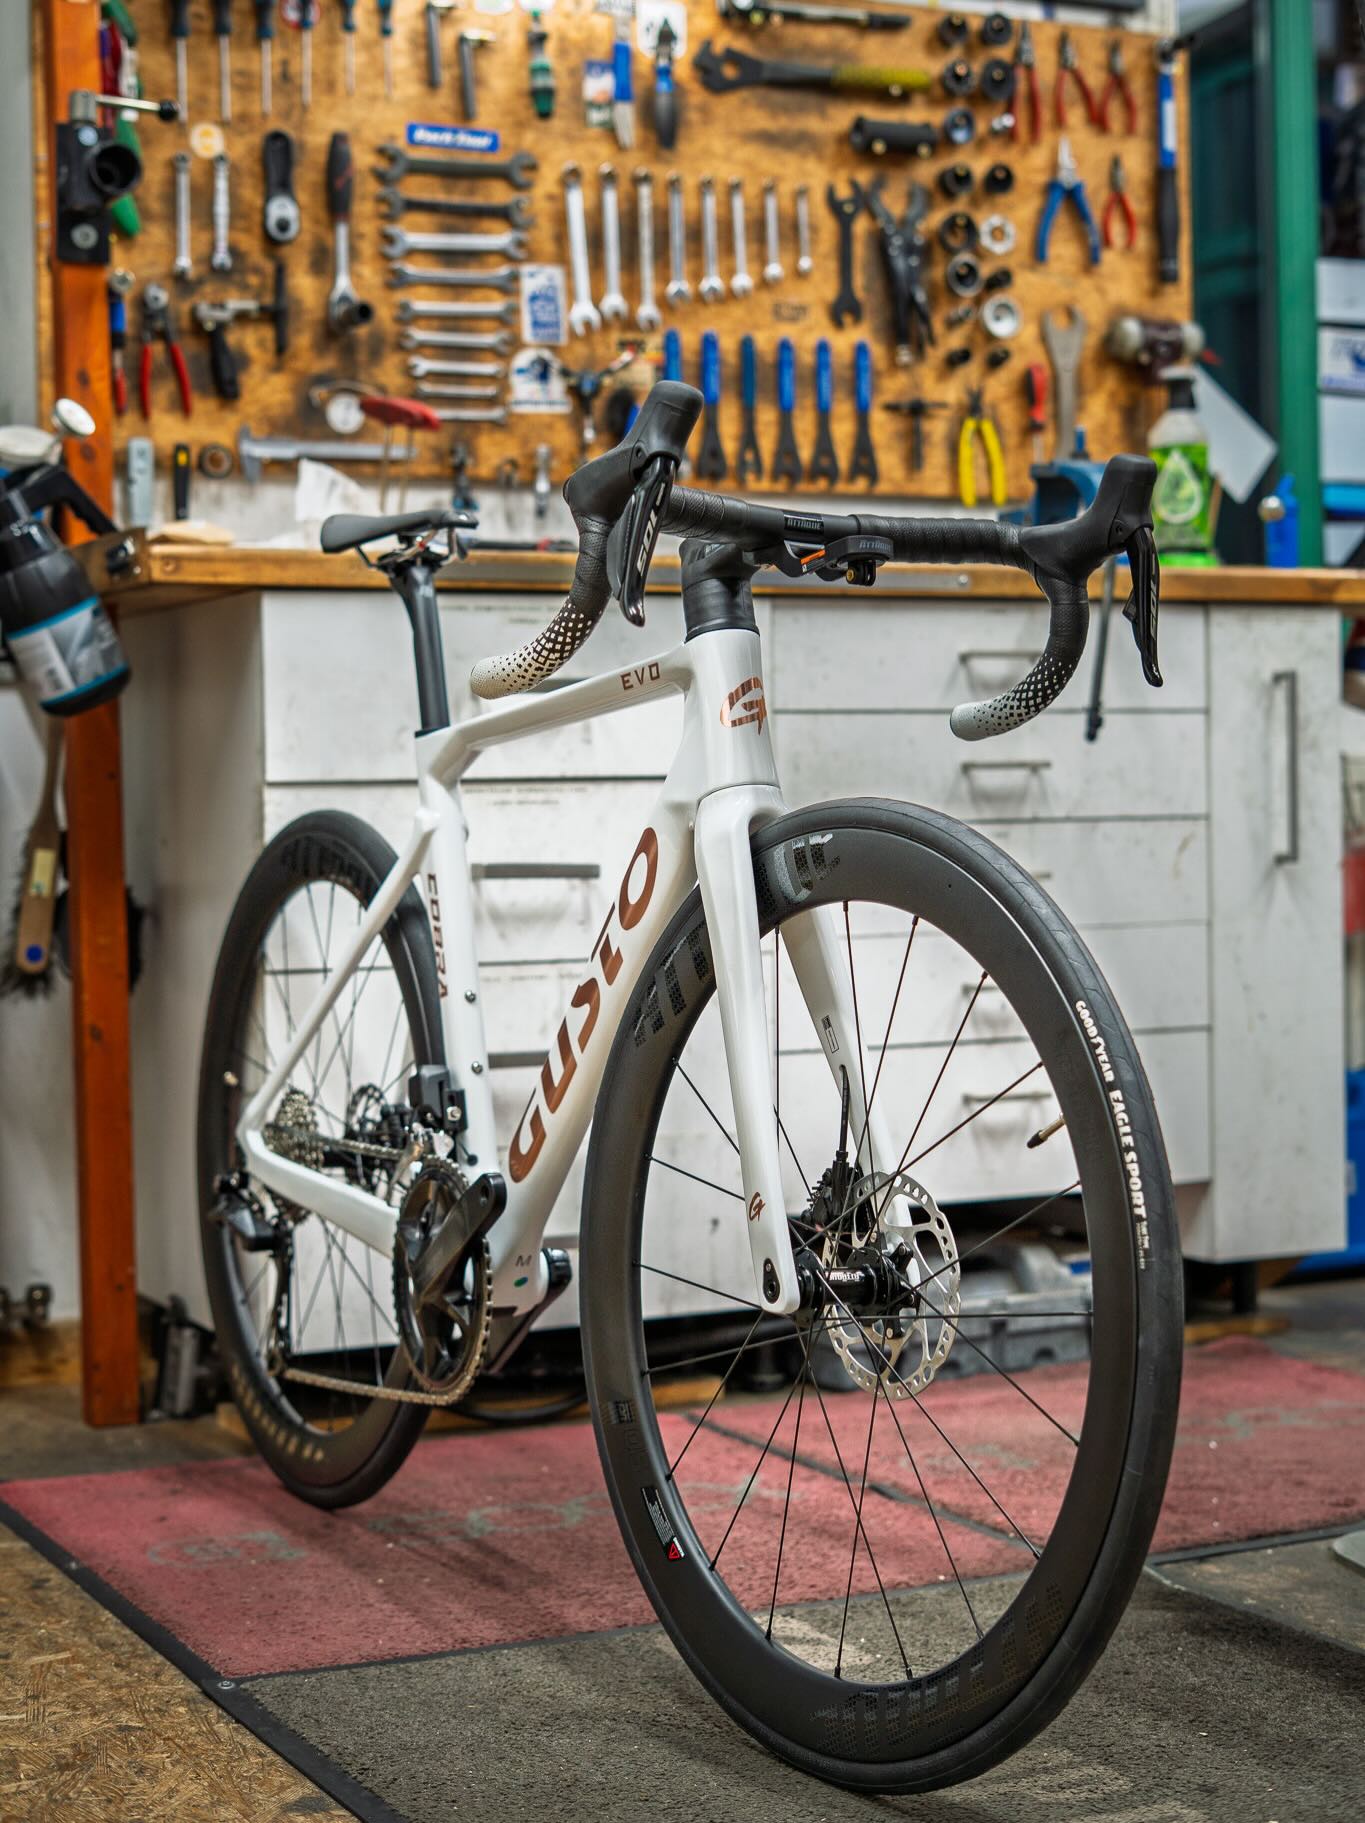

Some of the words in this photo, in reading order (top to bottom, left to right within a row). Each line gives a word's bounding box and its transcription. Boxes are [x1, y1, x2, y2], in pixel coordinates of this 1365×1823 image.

[620, 662, 661, 692] EVO
[427, 872, 449, 998] COBRA
[508, 827, 659, 1184] GUSTO
[1075, 1000, 1115, 1083] GOODYEAR
[1108, 1089, 1135, 1148] EAGLE
[1123, 1151, 1148, 1220] SPORT
